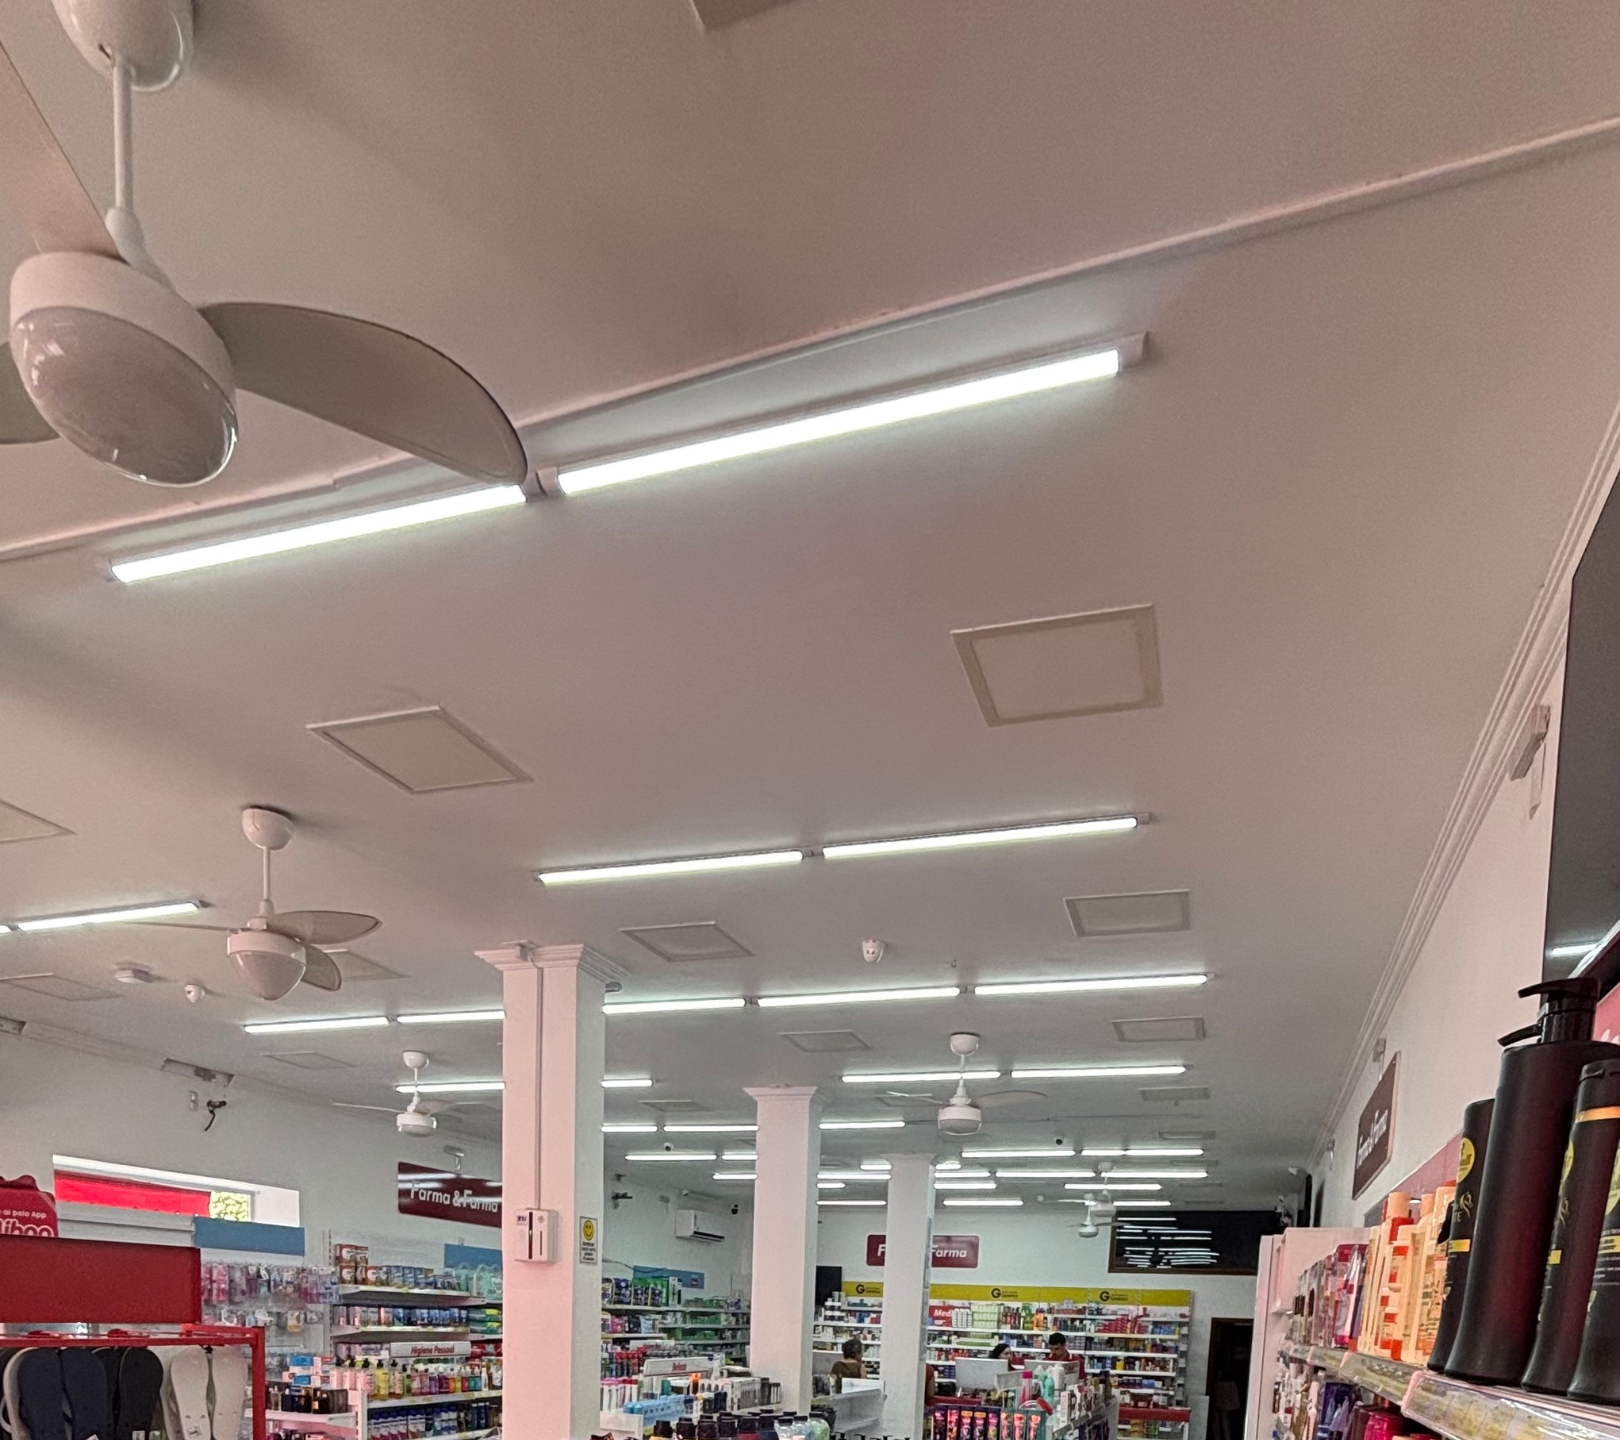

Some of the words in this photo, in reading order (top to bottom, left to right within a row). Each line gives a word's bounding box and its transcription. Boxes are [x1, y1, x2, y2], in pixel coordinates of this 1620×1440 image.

[410, 1182, 450, 1205] Farma
[463, 1189, 498, 1212] Farma
[31, 1211, 47, 1219] App
[856, 1284, 865, 1294] G
[991, 1288, 1001, 1299] G
[1100, 1291, 1110, 1301] G
[933, 1308, 953, 1318] Medi
[411, 1345, 434, 1355] Higiene
